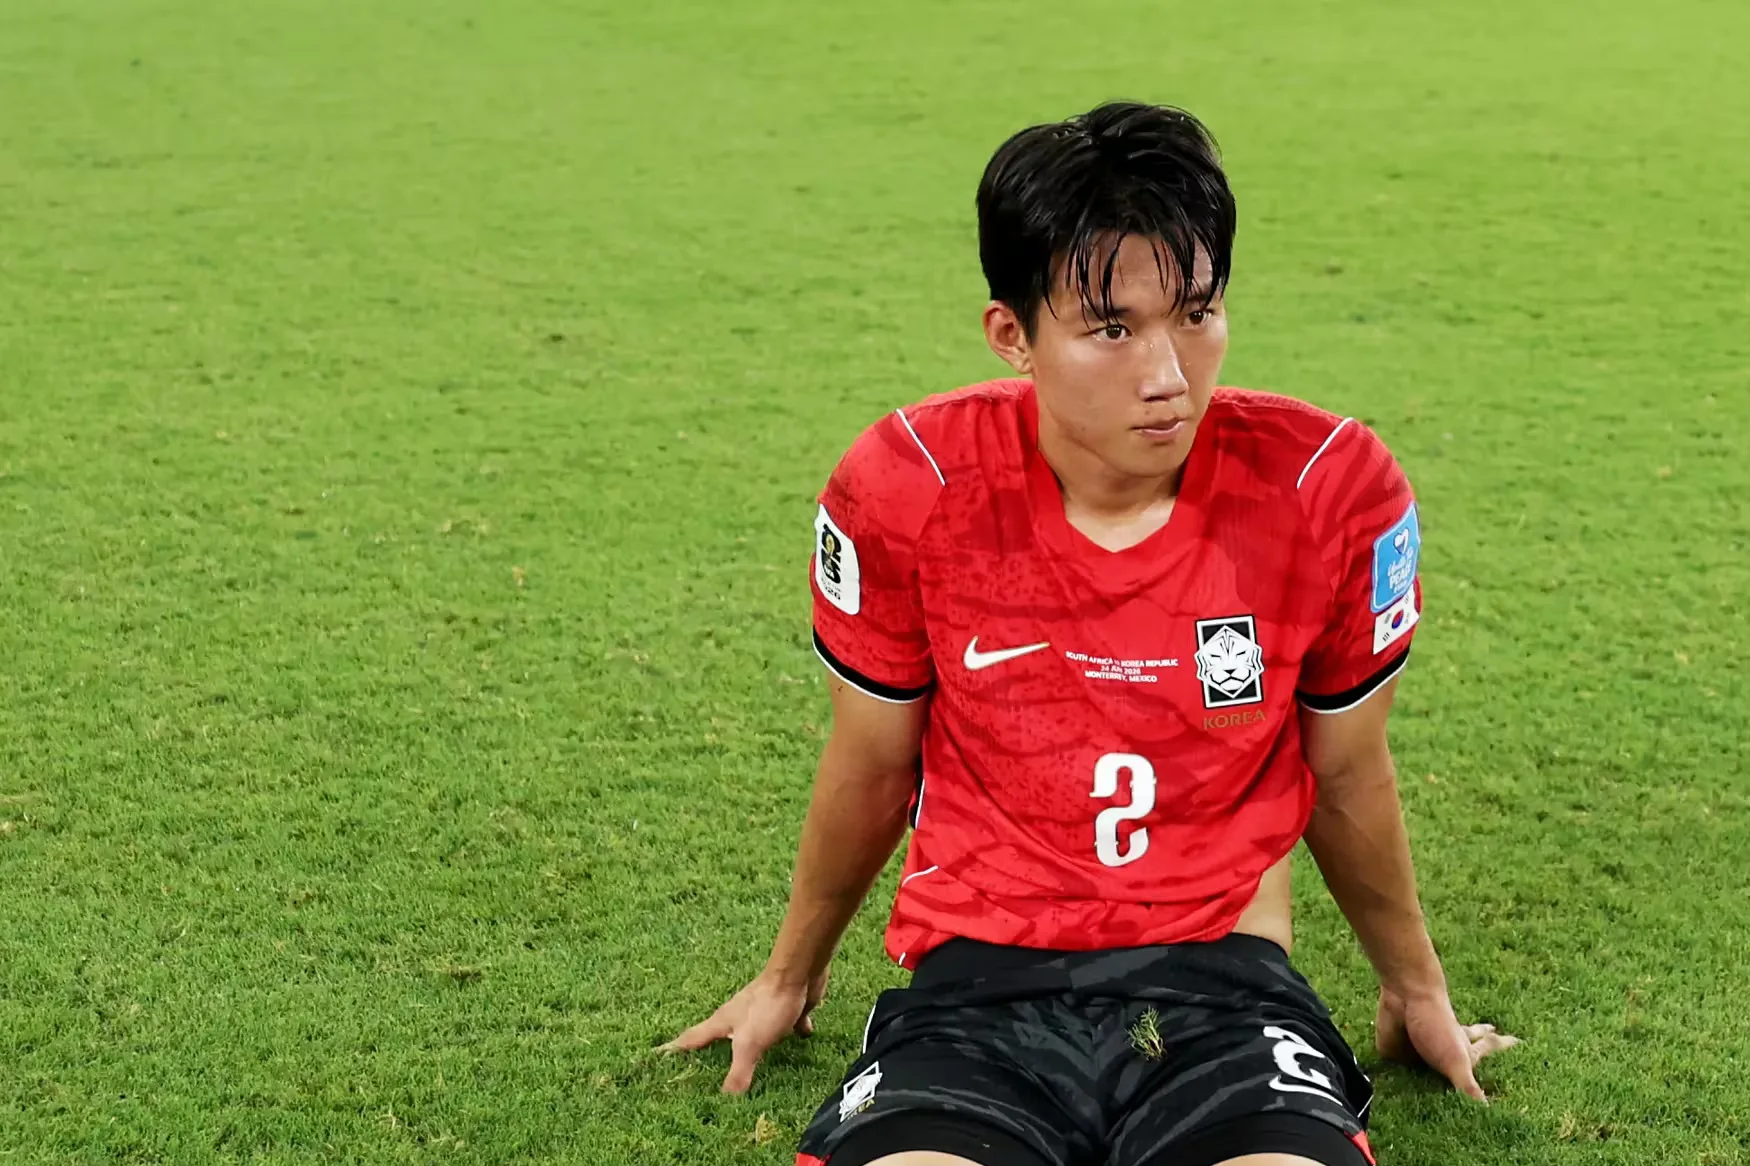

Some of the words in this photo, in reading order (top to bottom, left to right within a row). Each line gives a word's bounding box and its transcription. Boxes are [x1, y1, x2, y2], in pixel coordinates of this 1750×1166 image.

[1065, 651, 1088, 661] SOUTH
[1088, 656, 1113, 665] AFRICA
[1145, 659, 1179, 667] REPUBLIC
[1129, 675, 1157, 683] MEXICO
[1203, 709, 1266, 730] KOREA
[1089, 752, 1158, 868] 2
[1263, 1026, 1332, 1090] 2
